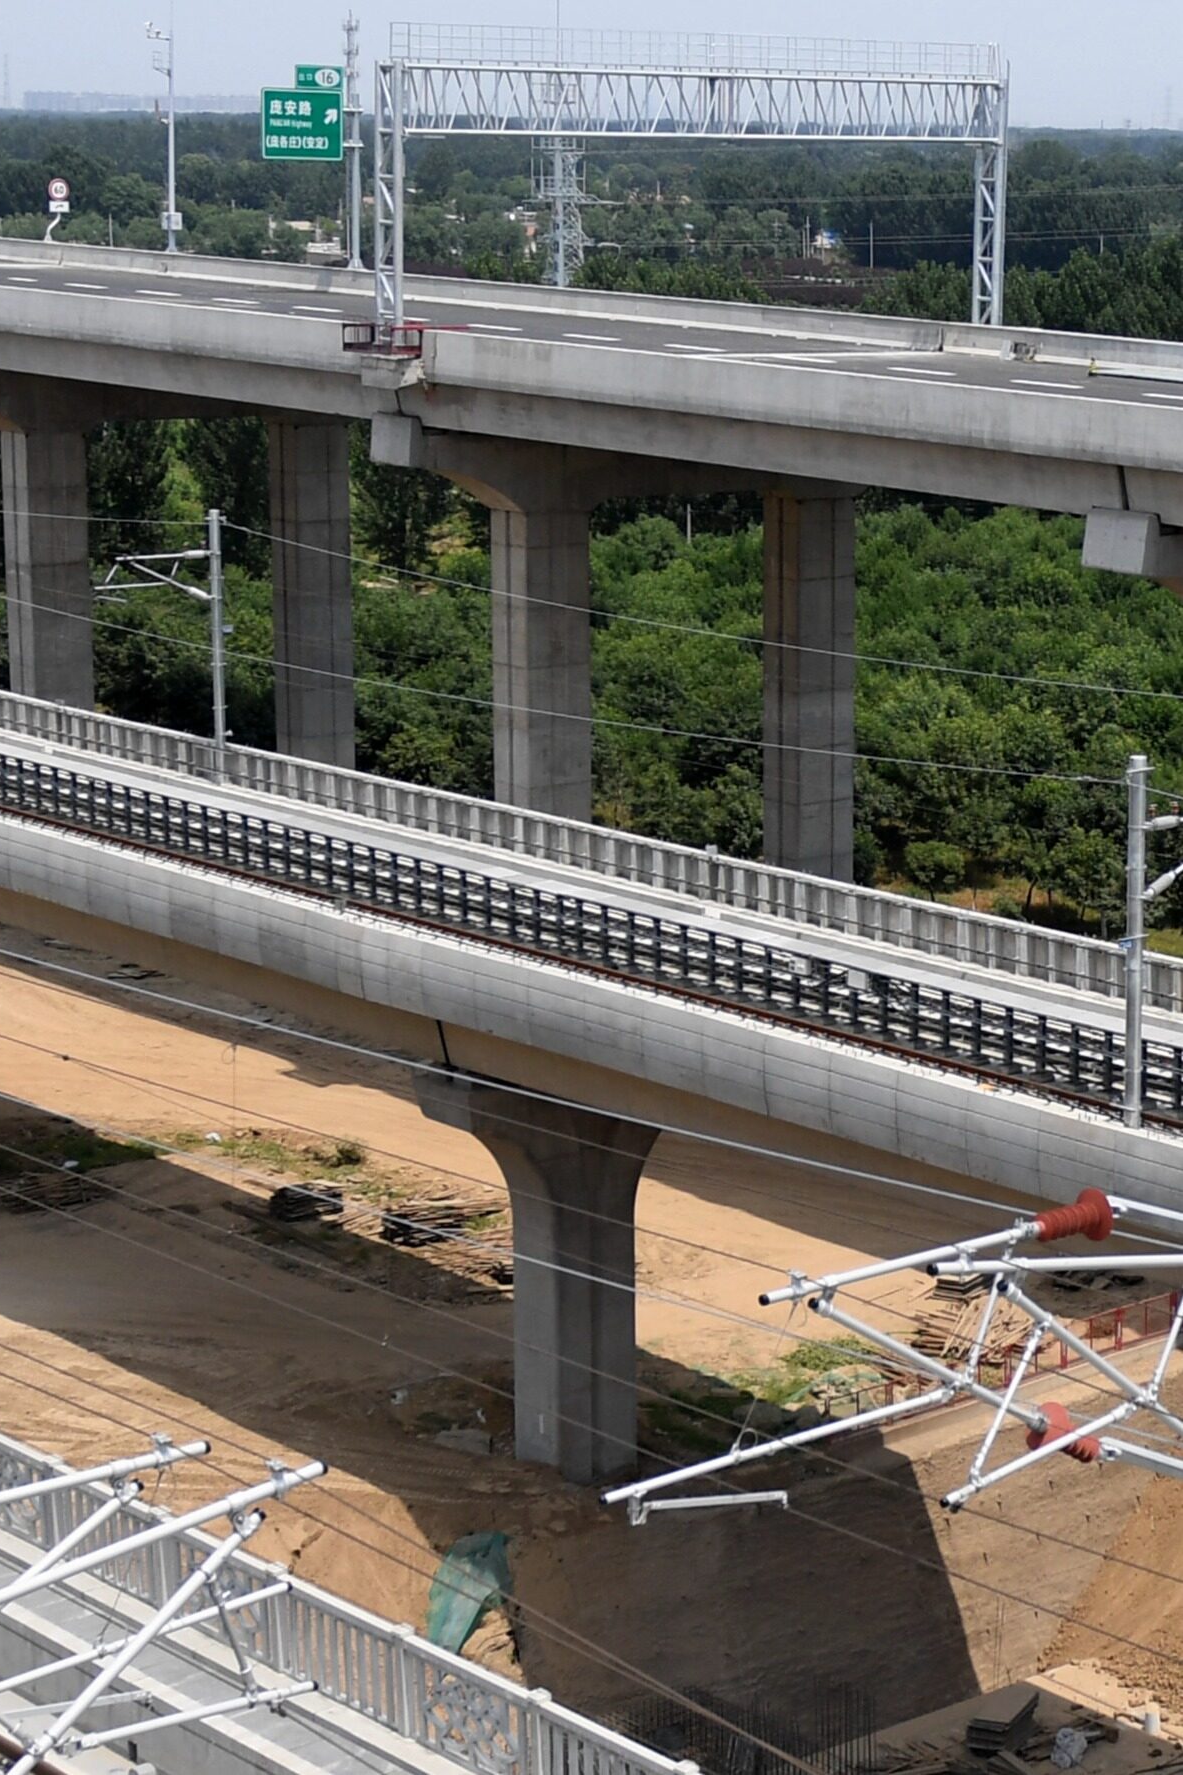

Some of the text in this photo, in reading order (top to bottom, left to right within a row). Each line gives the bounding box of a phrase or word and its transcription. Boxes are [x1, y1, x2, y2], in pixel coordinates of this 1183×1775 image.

[321, 72, 334, 84] 16
[269, 100, 311, 116] 庞安路
